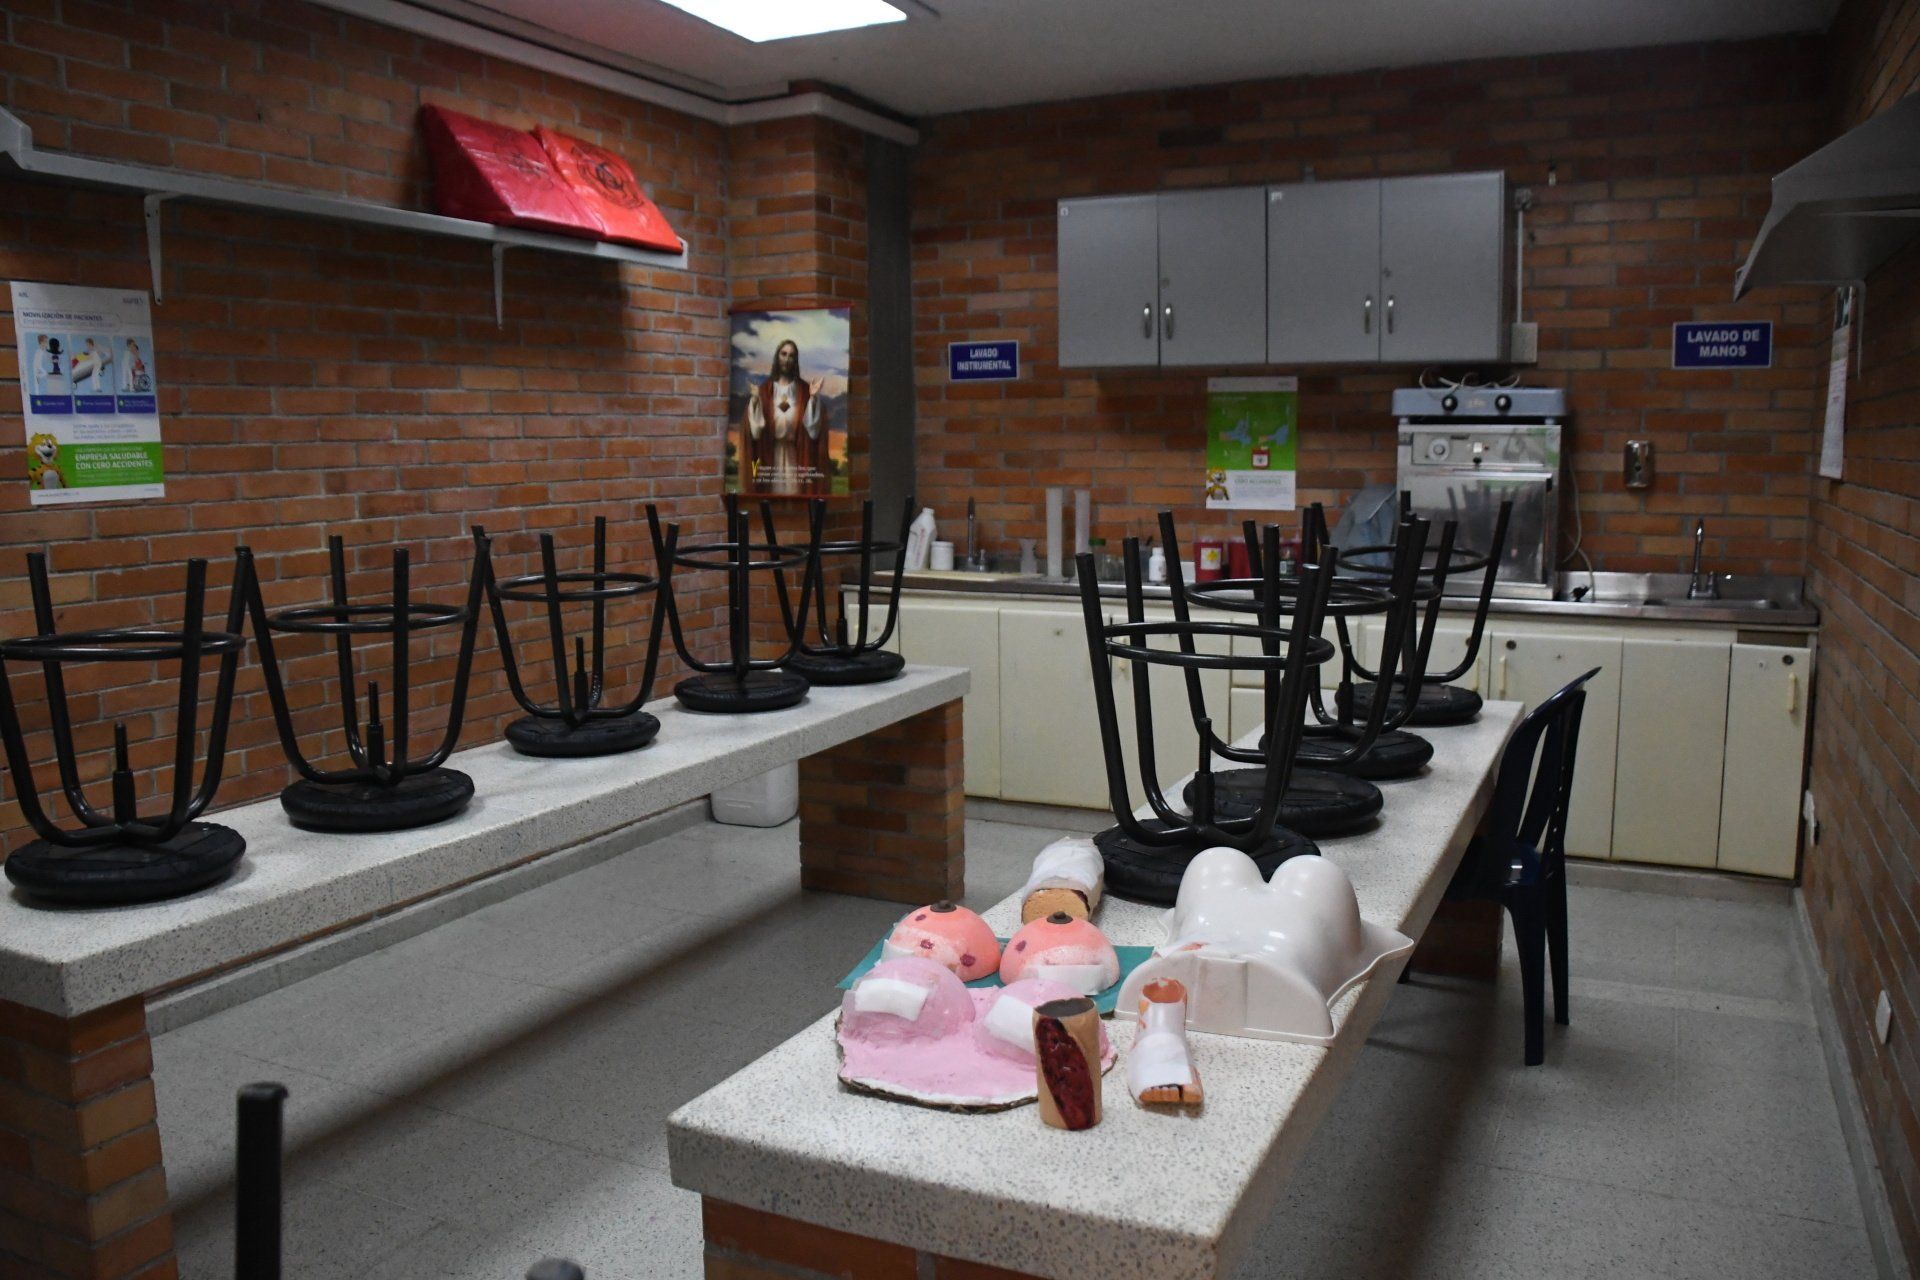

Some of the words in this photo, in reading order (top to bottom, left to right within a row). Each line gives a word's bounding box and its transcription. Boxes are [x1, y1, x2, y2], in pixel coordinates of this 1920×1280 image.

[1687, 330, 1739, 343] LAVADO
[1743, 329, 1760, 342] DE
[970, 347, 998, 359] LAVADO
[1700, 345, 1747, 357] MANOS
[957, 360, 1011, 371] INSTRUMENTAL
[75, 452, 108, 462] EMPRESA
[110, 451, 148, 460] SALUDABLE
[76, 461, 91, 470] CON
[92, 461, 111, 469] CERO
[112, 459, 153, 468] ACCIDENTES
